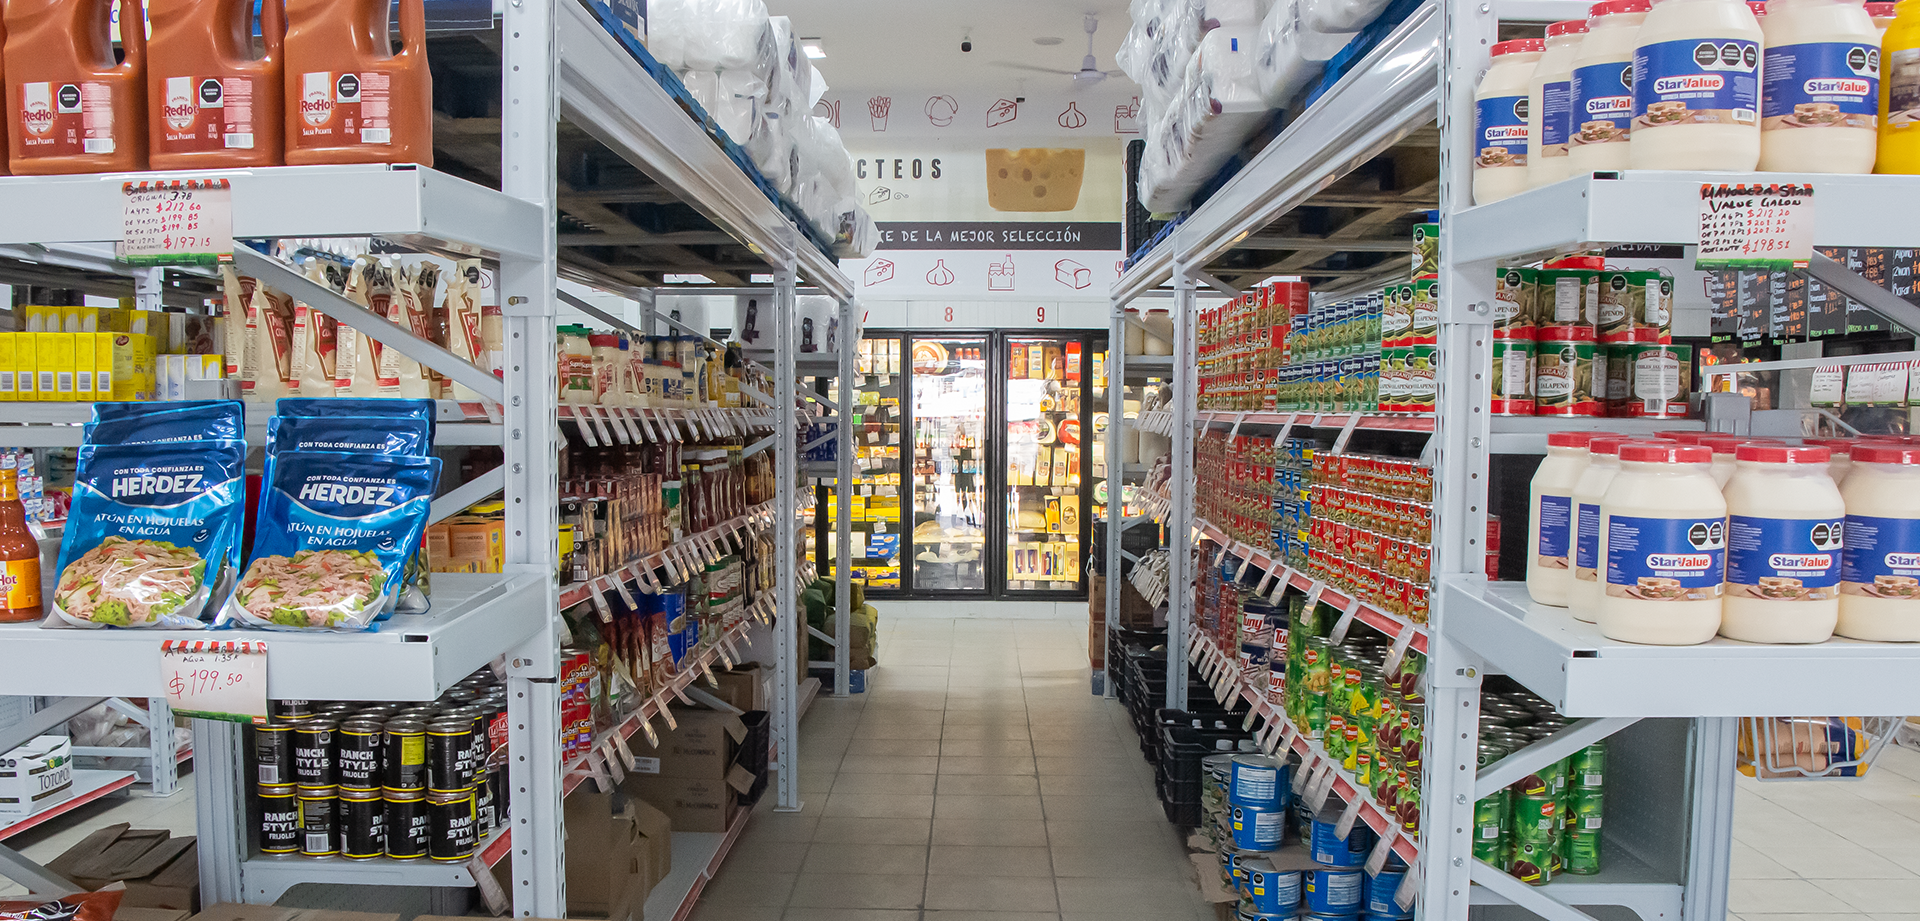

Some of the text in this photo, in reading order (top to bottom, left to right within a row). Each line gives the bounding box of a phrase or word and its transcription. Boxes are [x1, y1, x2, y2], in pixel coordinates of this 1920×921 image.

[1588, 98, 1630, 111] StarVal
[1487, 127, 1528, 138] StarValu
[857, 158, 942, 179] CTEOS
[163, 234, 210, 249] $197.15
[902, 226, 1081, 243] DE LA MEJOR SELECCIÓN
[1742, 239, 1790, 255] $198.51
[944, 307, 953, 322] 8
[1036, 307, 1045, 322] 9
[112, 474, 204, 497] HERDEZ
[299, 483, 394, 507] HERDEZ
[94, 513, 204, 527] ATÚN EN HOJUELAS
[119, 526, 170, 535] EN AGUA
[287, 522, 391, 538] ATÚN EN HOJUELAS
[307, 537, 323, 545] EN
[1243, 613, 1263, 631] Tuny
[1276, 630, 1287, 643] Tu
[169, 669, 243, 700] $199.50
[340, 749, 374, 760] RANCH
[296, 758, 329, 768] TYLE
[340, 760, 376, 770] STYLE
[264, 812, 297, 822] RANCH
[450, 818, 472, 828] RANC
[447, 829, 472, 839] STYL
